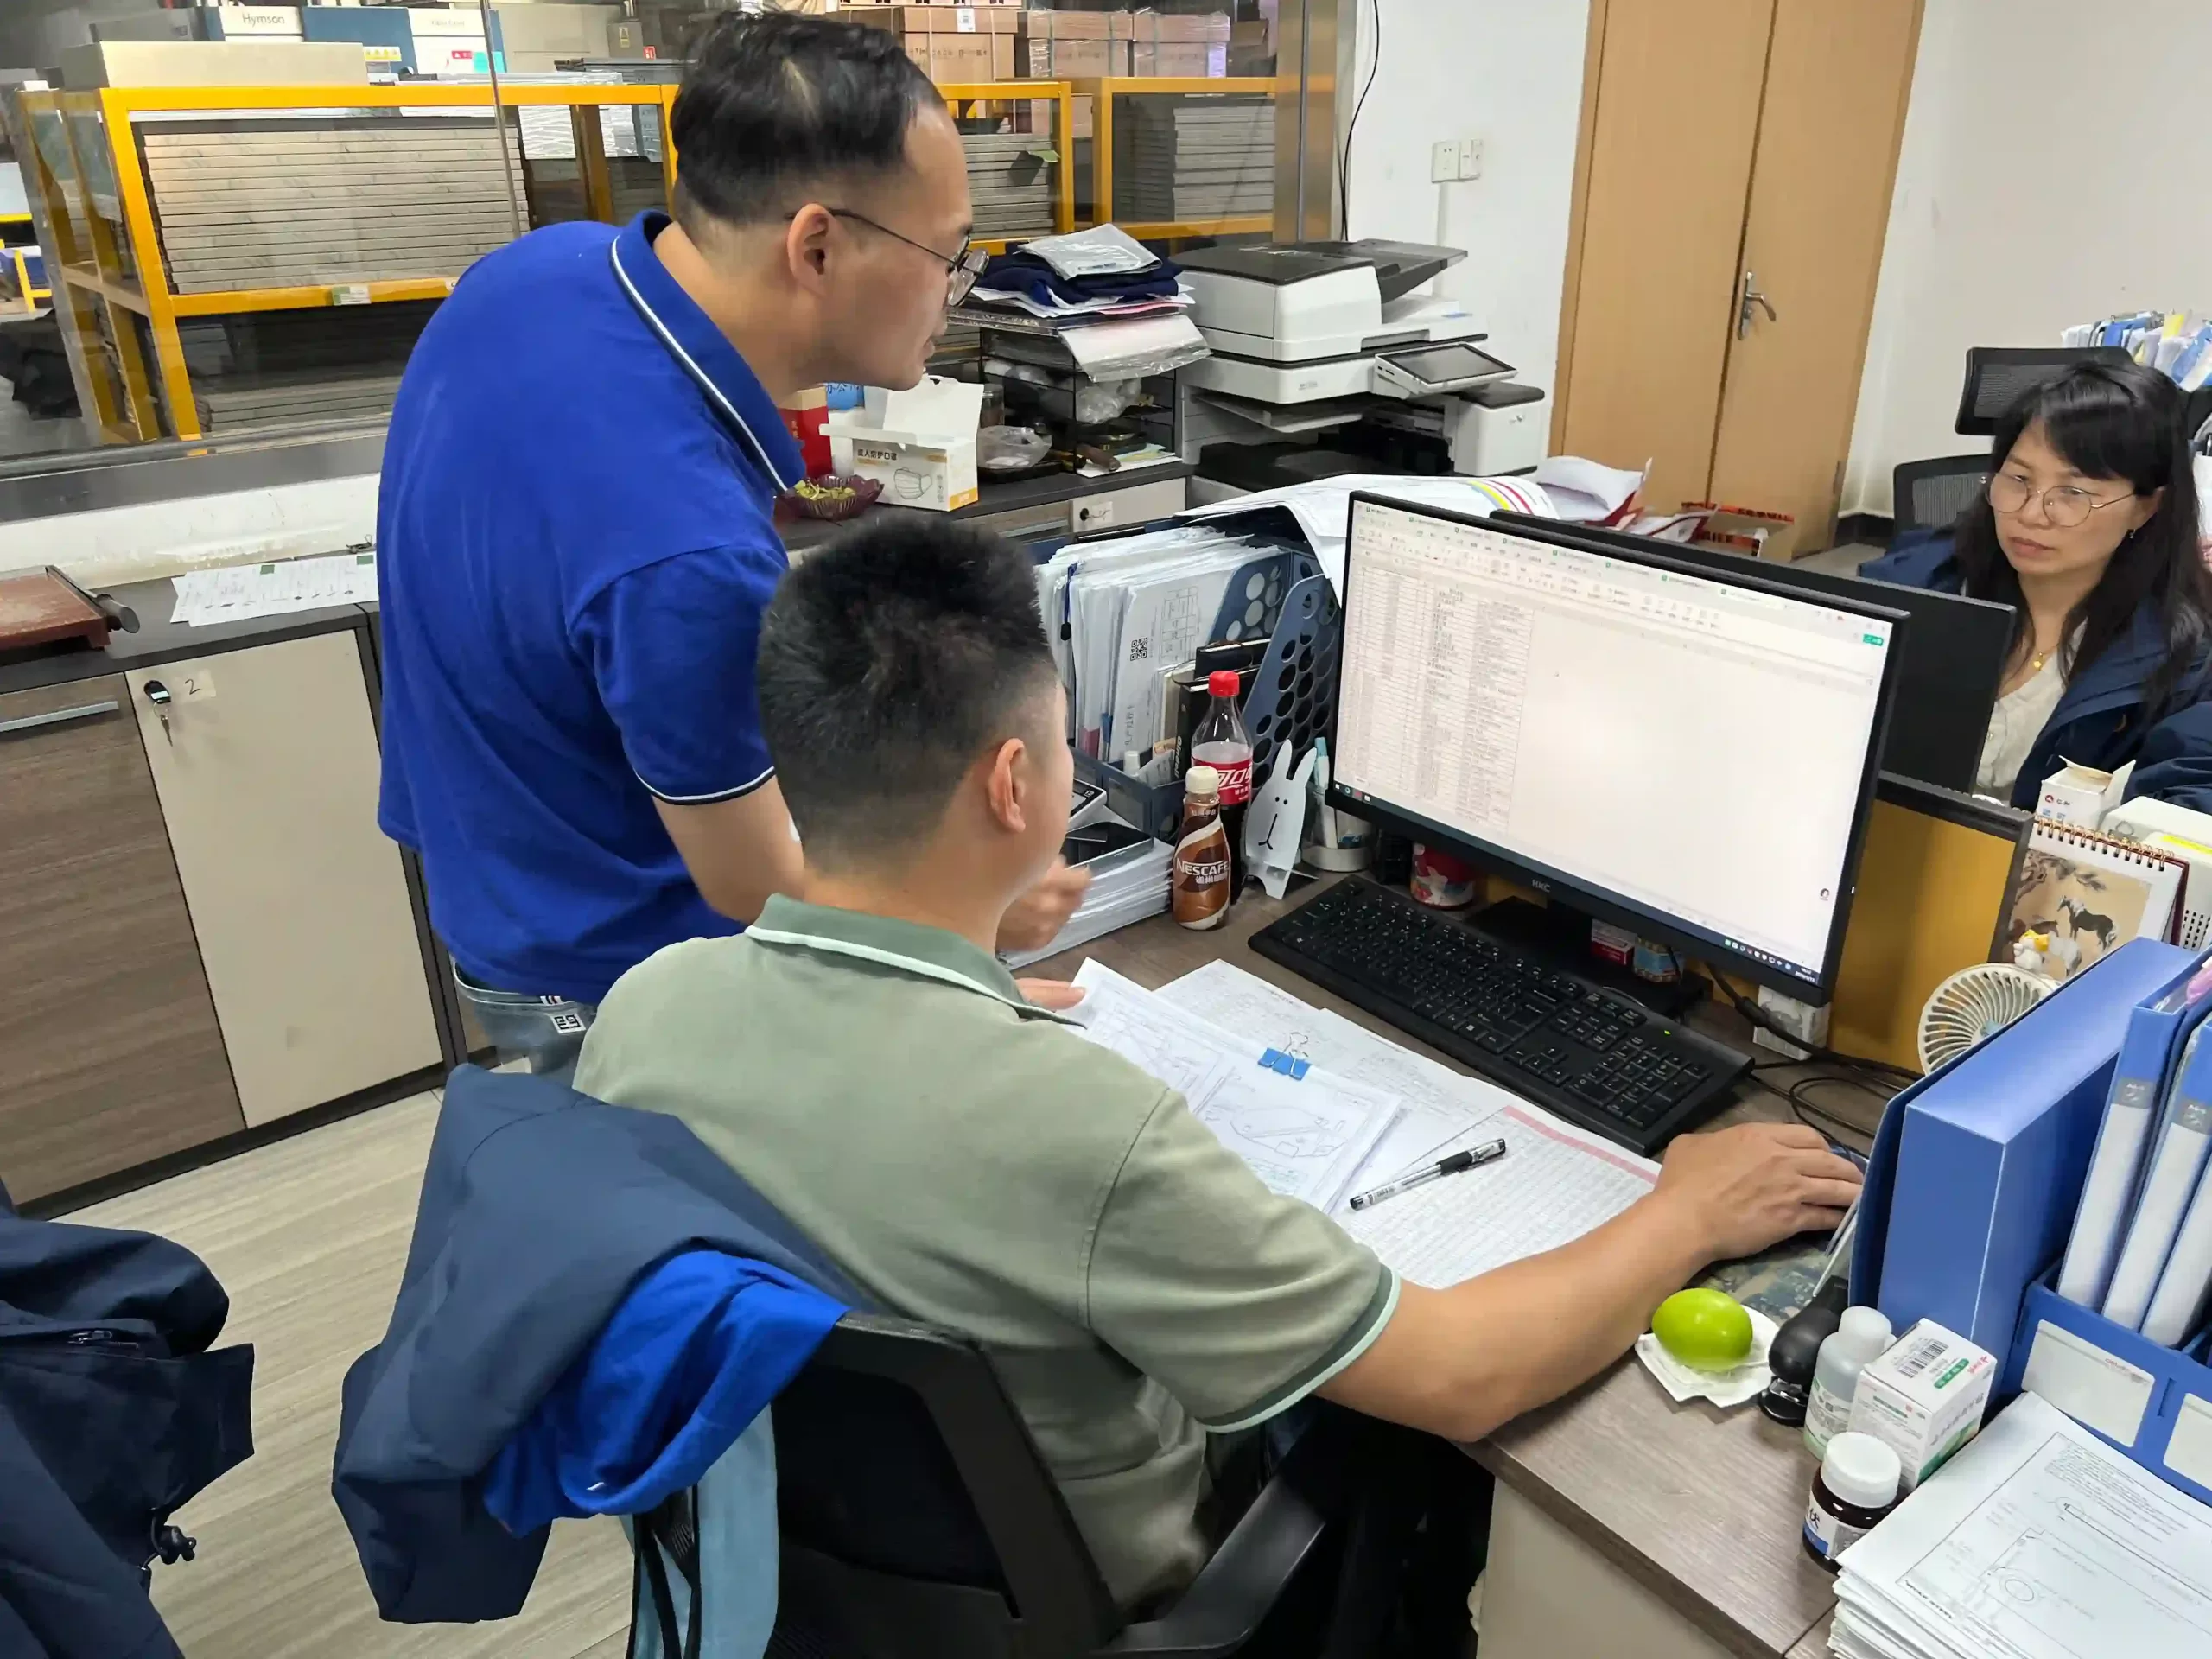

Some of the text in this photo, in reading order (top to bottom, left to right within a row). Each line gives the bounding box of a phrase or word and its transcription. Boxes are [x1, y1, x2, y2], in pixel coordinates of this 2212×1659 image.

[242, 13, 285, 27] Hymson
[185, 678, 201, 695] 2
[1531, 879, 1551, 893] HKC
